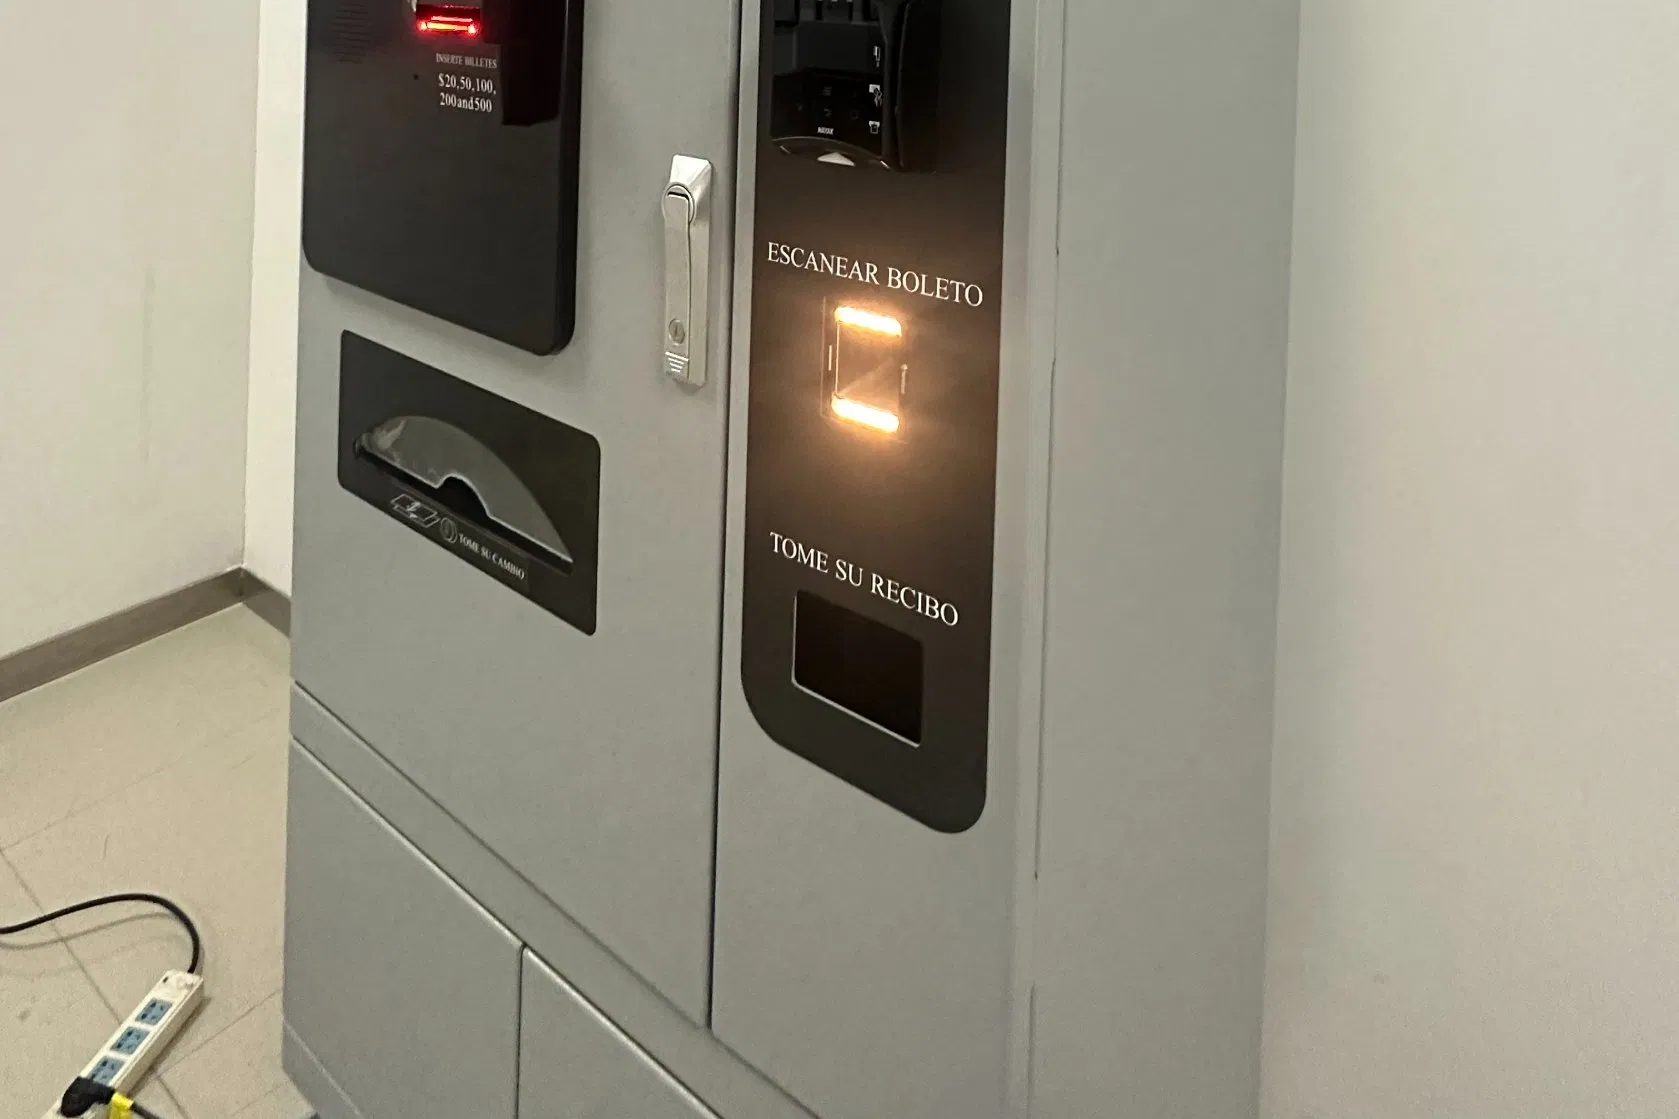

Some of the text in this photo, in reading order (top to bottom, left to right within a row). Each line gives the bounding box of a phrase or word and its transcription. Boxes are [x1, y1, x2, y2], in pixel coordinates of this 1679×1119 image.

[767, 241, 984, 307] ESCANEAR BOLETO
[769, 531, 959, 628] TOME SU RECIBO
